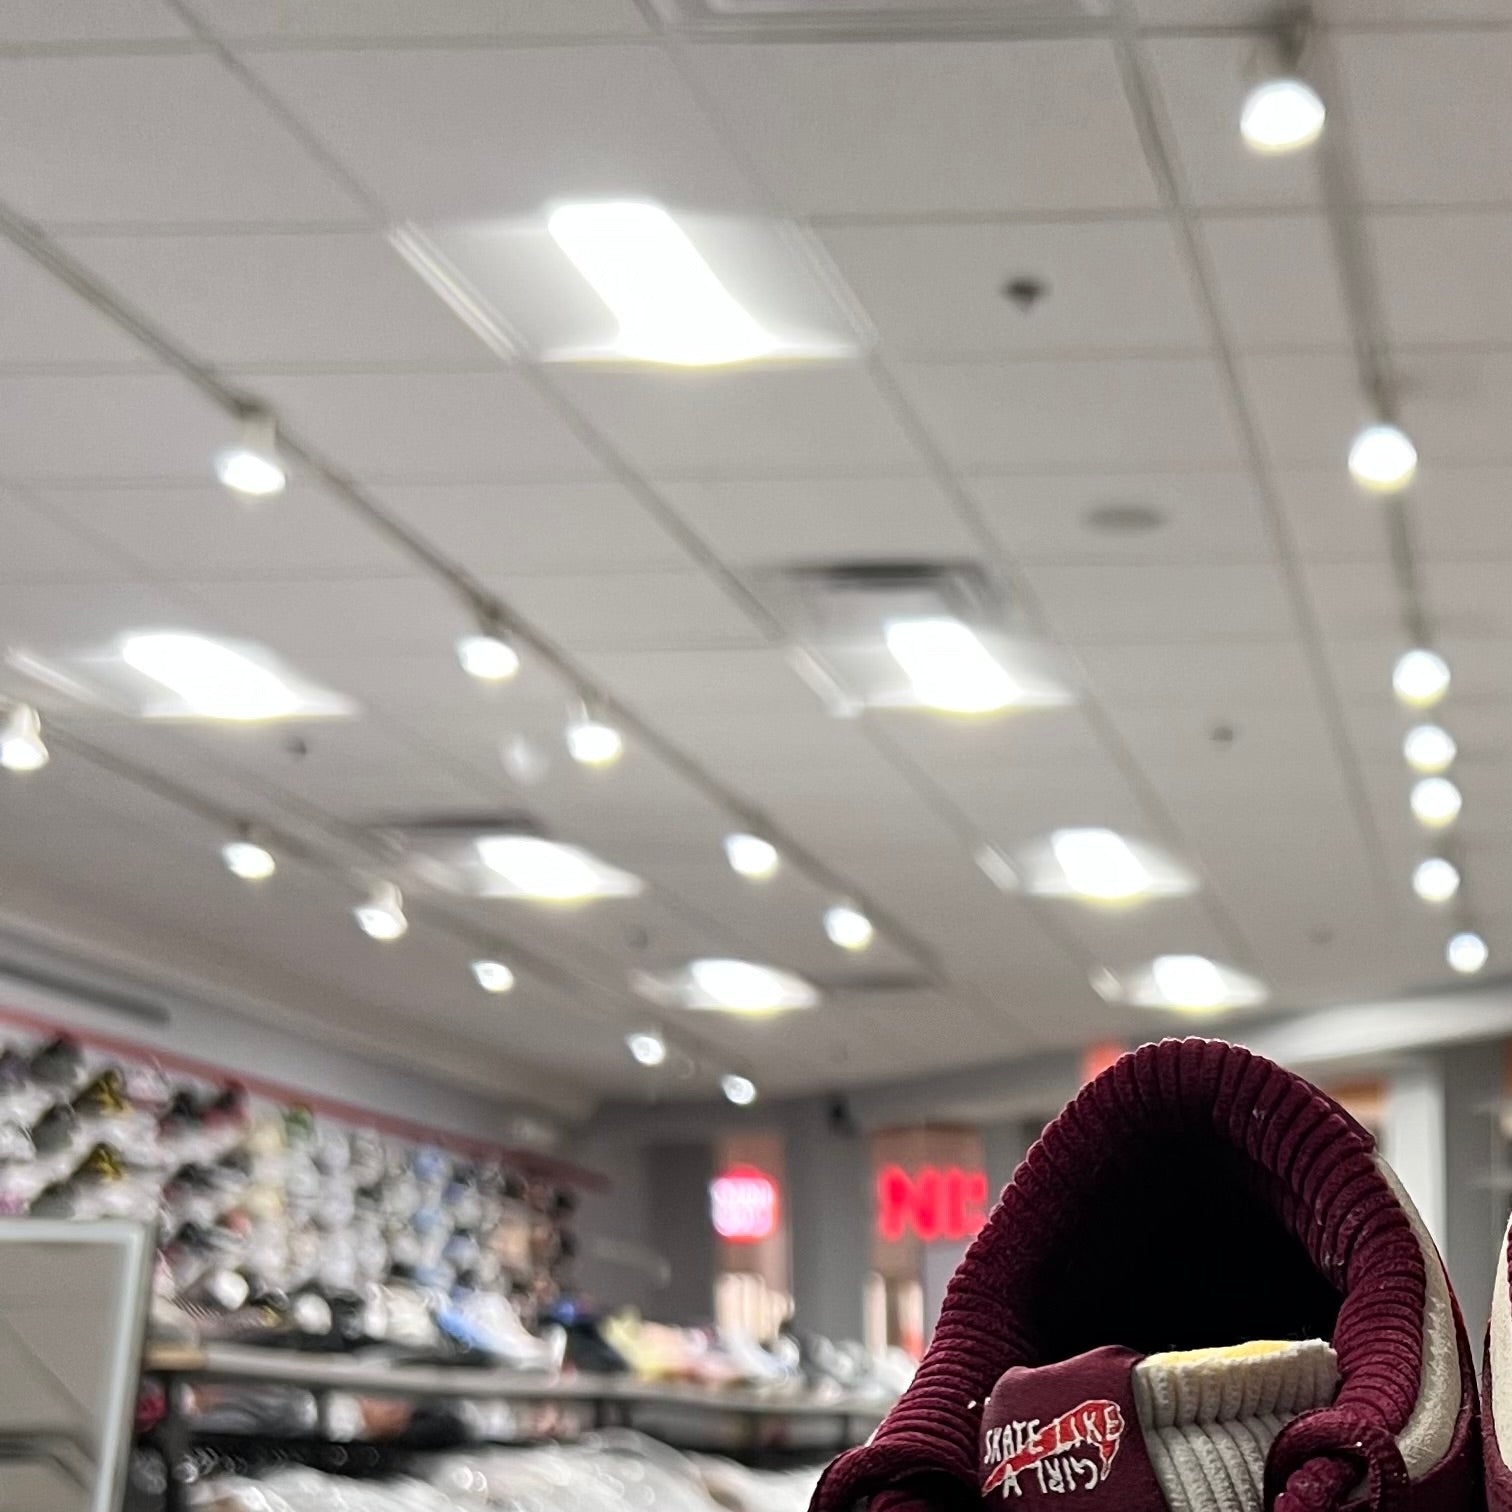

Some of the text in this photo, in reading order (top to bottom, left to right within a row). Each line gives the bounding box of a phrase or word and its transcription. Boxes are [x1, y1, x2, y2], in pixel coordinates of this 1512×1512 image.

[984, 1405, 1120, 1464] SKATE LIKE
[1003, 1463, 1022, 1498] A
